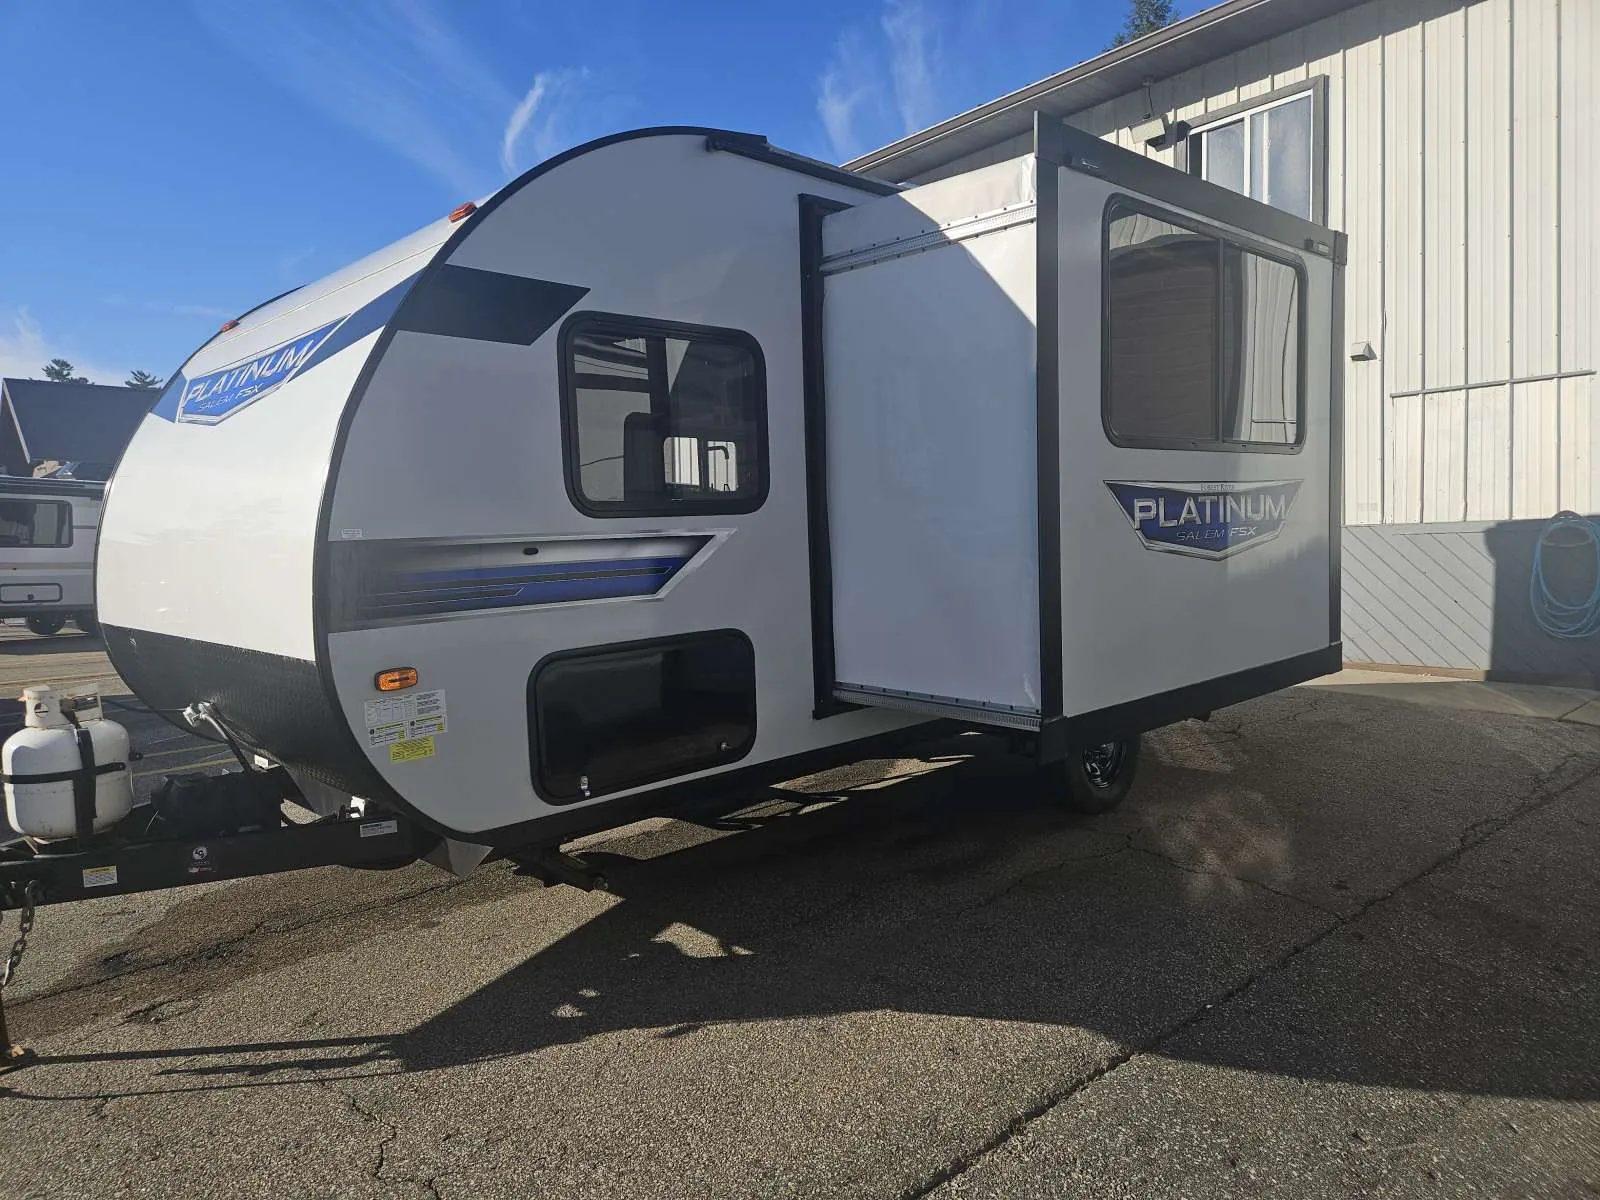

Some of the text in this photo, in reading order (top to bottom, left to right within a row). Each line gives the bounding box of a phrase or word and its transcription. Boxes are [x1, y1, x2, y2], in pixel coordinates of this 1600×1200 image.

[184, 339, 314, 407] PLATINUM
[1133, 494, 1287, 530] PLATINUM
[1176, 526, 1258, 541] SALEM FSX
